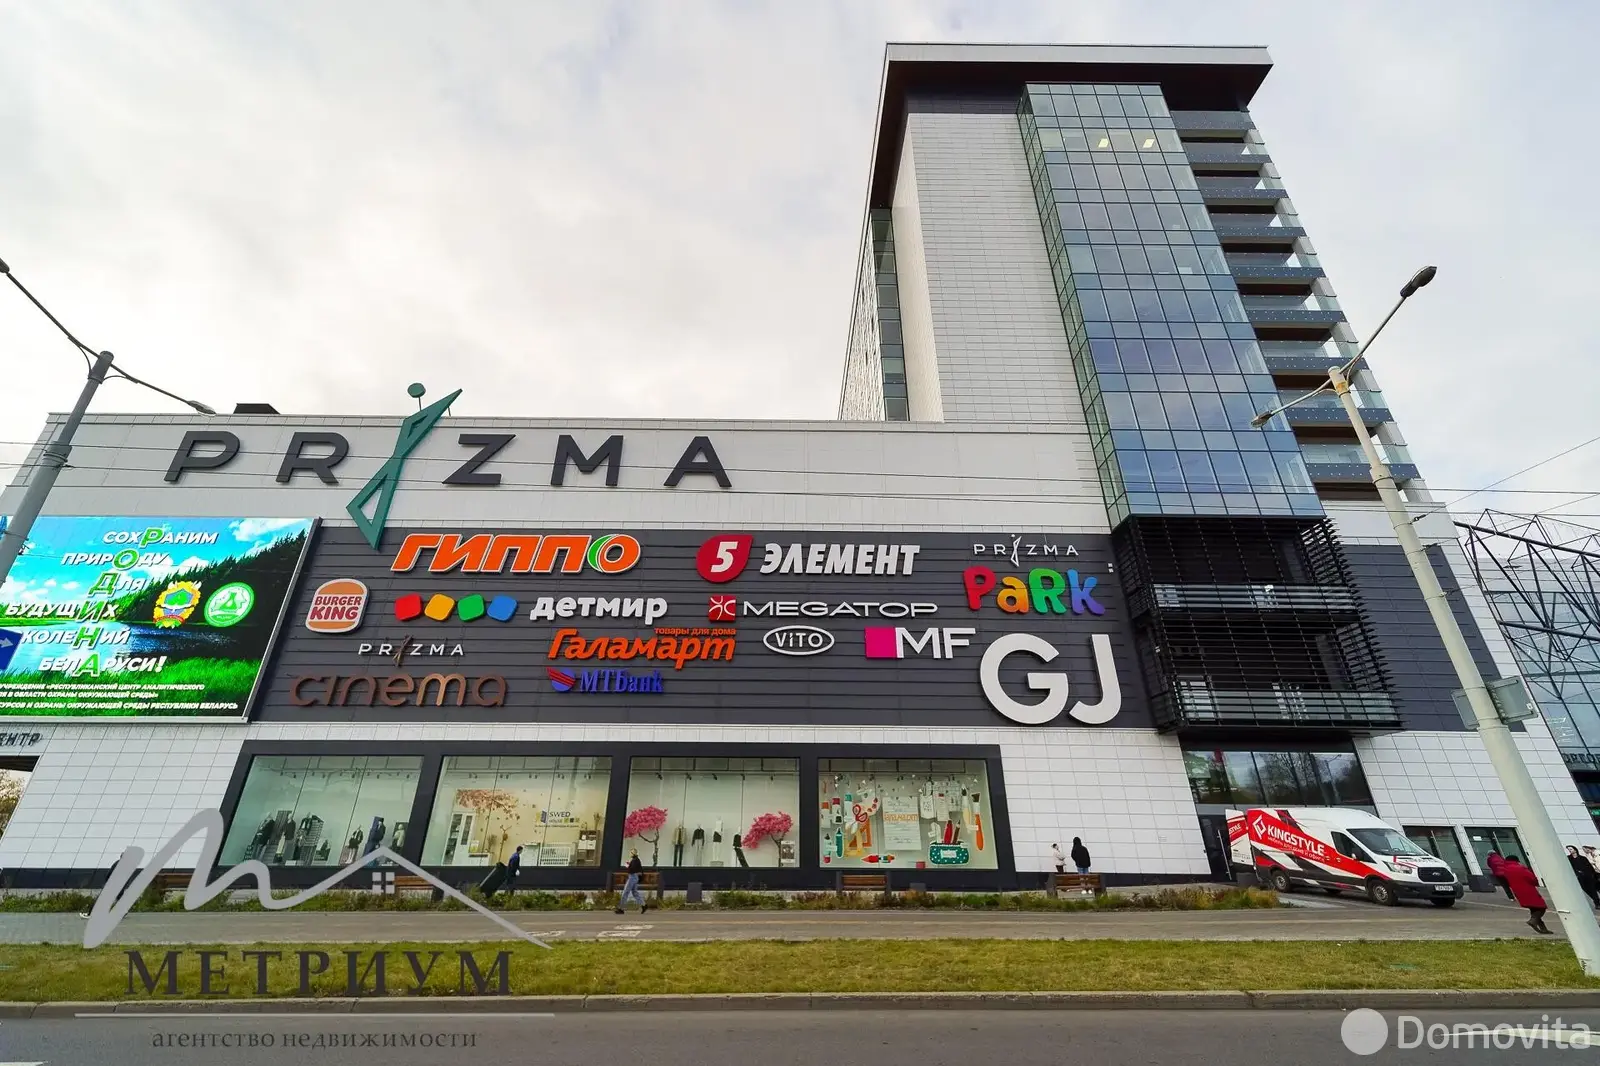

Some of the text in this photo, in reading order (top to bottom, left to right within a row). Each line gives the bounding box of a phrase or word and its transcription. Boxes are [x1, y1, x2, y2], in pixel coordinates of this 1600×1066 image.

[103, 527, 219, 548] СОХРАНИМ
[61, 548, 171, 571] ПРИРОДУ
[391, 533, 641, 574] ГИППО
[710, 542, 920, 574] 5 ЭЛЕМЕНТ
[87, 572, 149, 597] ДЛЯ
[4, 600, 119, 623] БУДУЩИХ
[310, 606, 359, 620] KING
[314, 596, 362, 606] BURGER
[530, 597, 668, 624] детмир
[743, 602, 938, 617] MEGATOP
[655, 628, 689, 637] товары
[713, 628, 737, 636] дома
[896, 627, 977, 659] MF
[548, 629, 737, 670] Галамарт
[38, 652, 167, 678] БЕЛАРУСИ!
[290, 673, 507, 707] cinema
[579, 668, 664, 693] МТБанк
[979, 633, 1122, 725] GJ
[1267, 824, 1325, 856] KINGSTYLE
